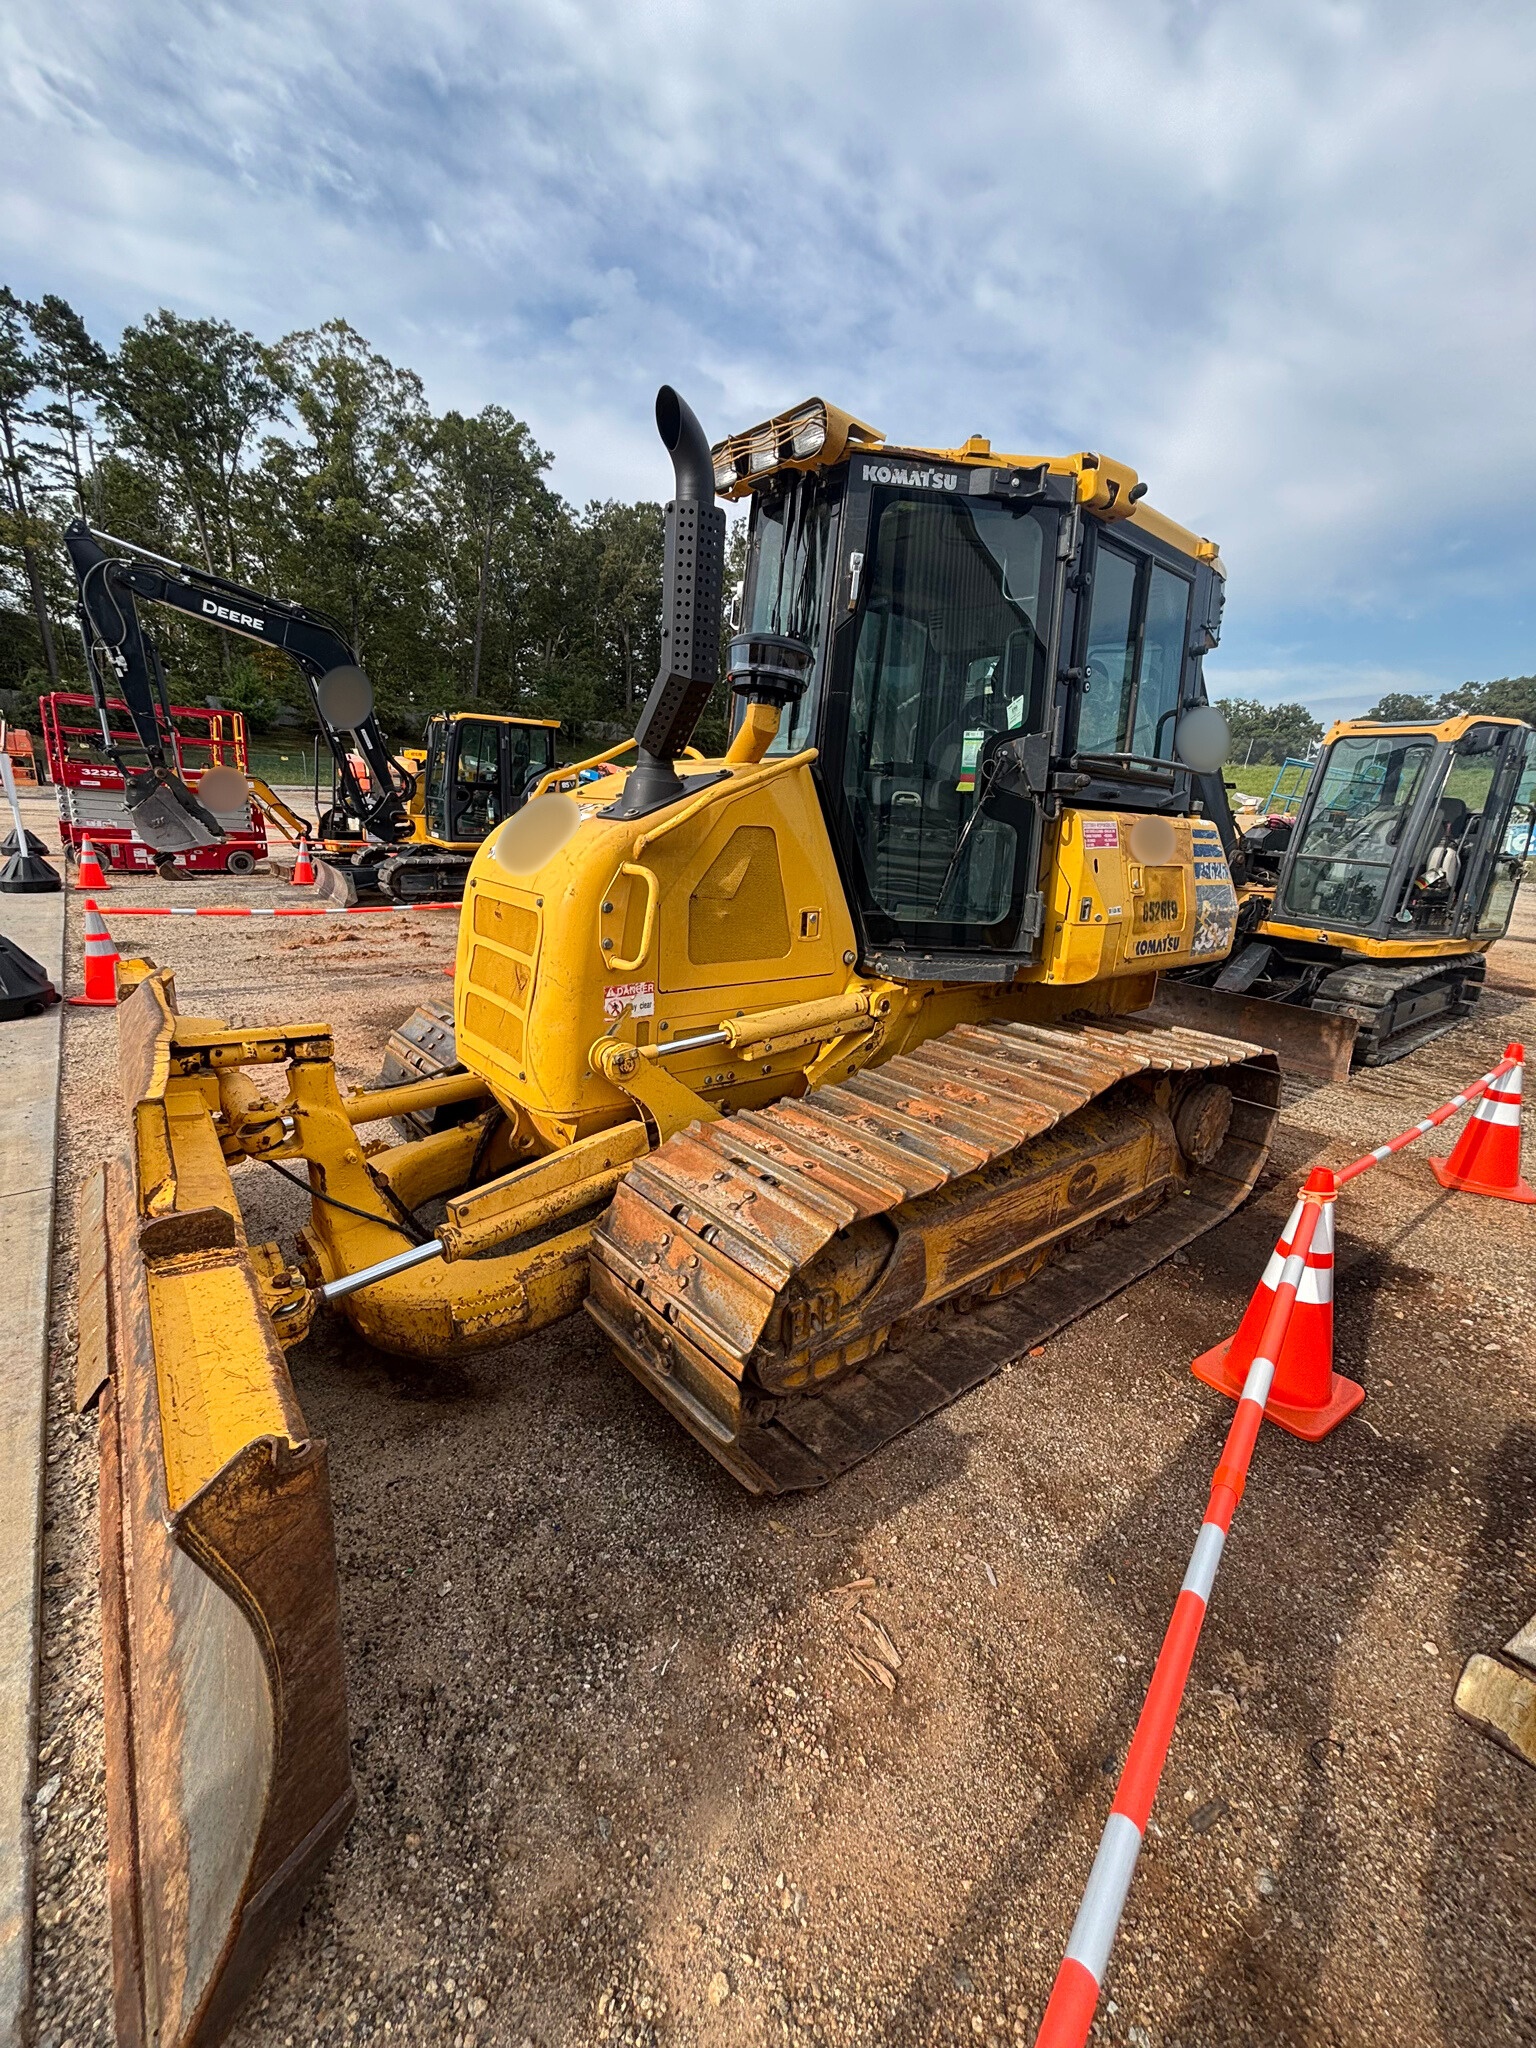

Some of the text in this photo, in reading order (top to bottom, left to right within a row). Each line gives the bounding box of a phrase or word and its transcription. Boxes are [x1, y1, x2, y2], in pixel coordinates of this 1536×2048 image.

[862, 464, 958, 490] KOMATSU
[202, 599, 264, 631] DEERE
[616, 983, 654, 996] DANGER
[639, 1001, 652, 1010] clear
